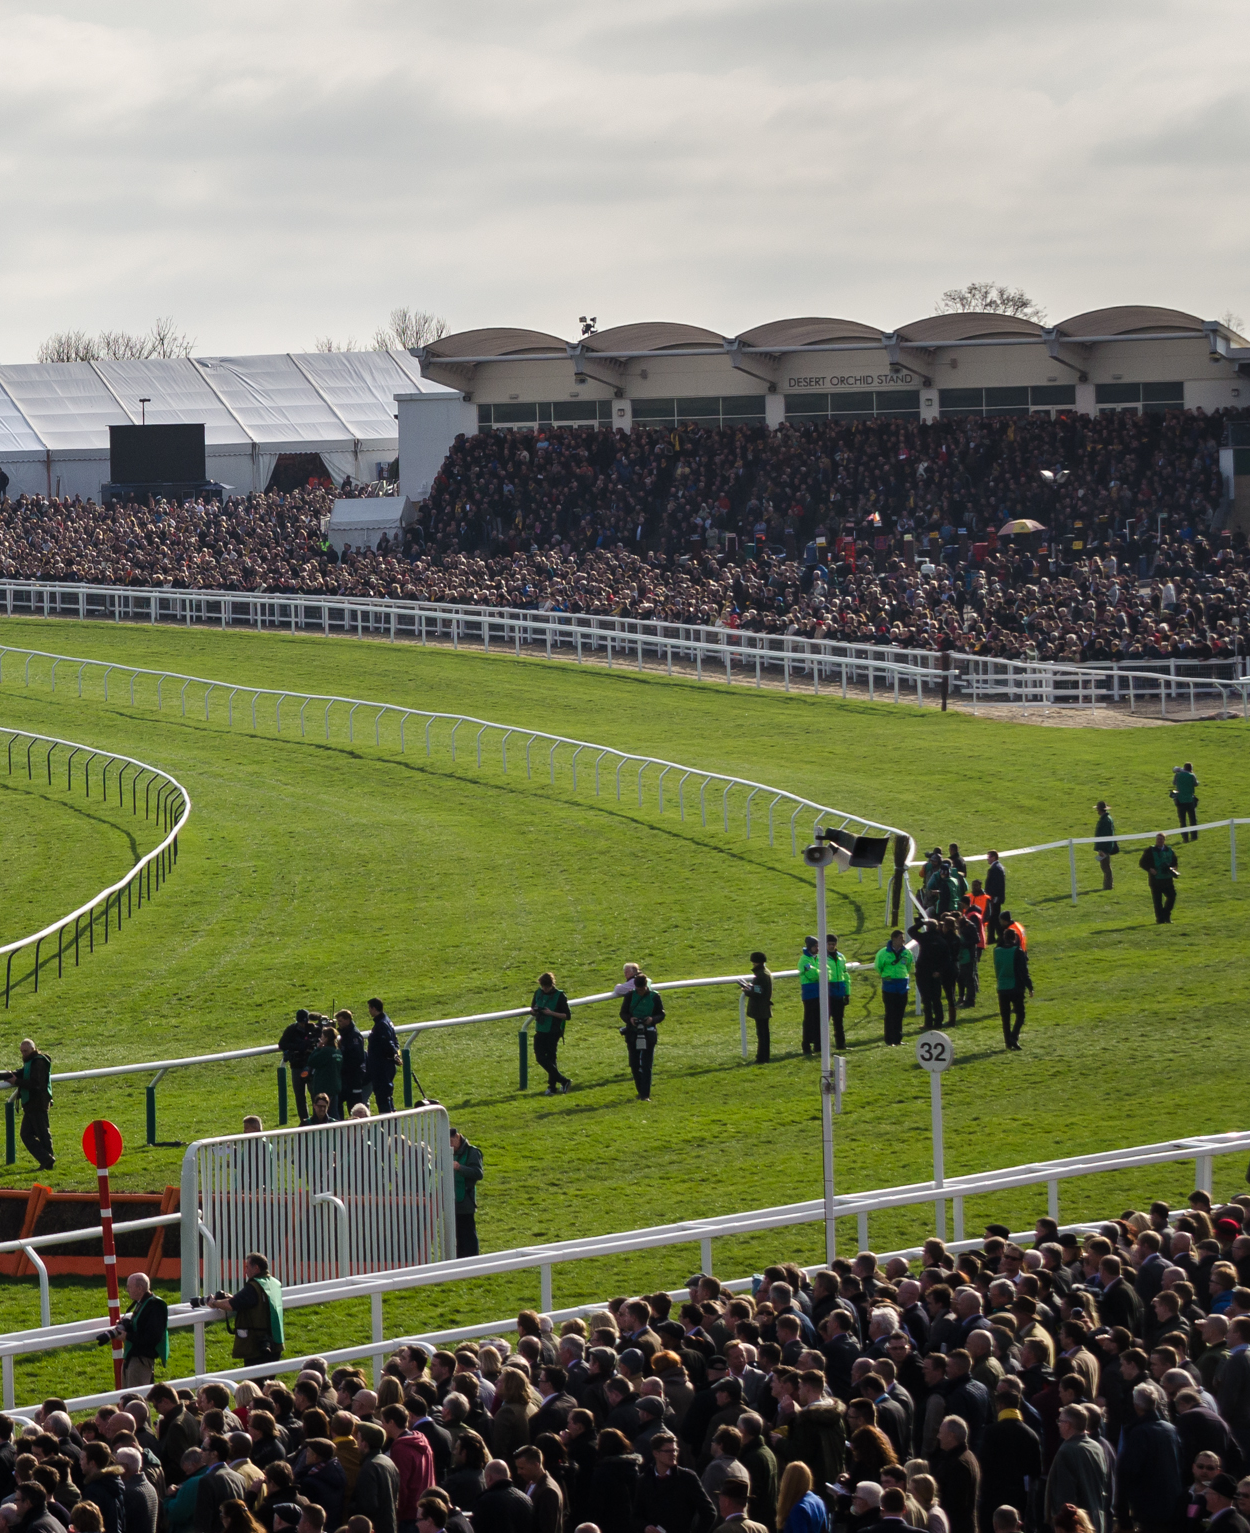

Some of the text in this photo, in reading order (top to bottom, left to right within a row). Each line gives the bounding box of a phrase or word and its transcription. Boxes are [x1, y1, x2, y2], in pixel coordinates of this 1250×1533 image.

[788, 374, 913, 387] DESERT ORCHID STAND
[920, 1042, 947, 1062] 32
